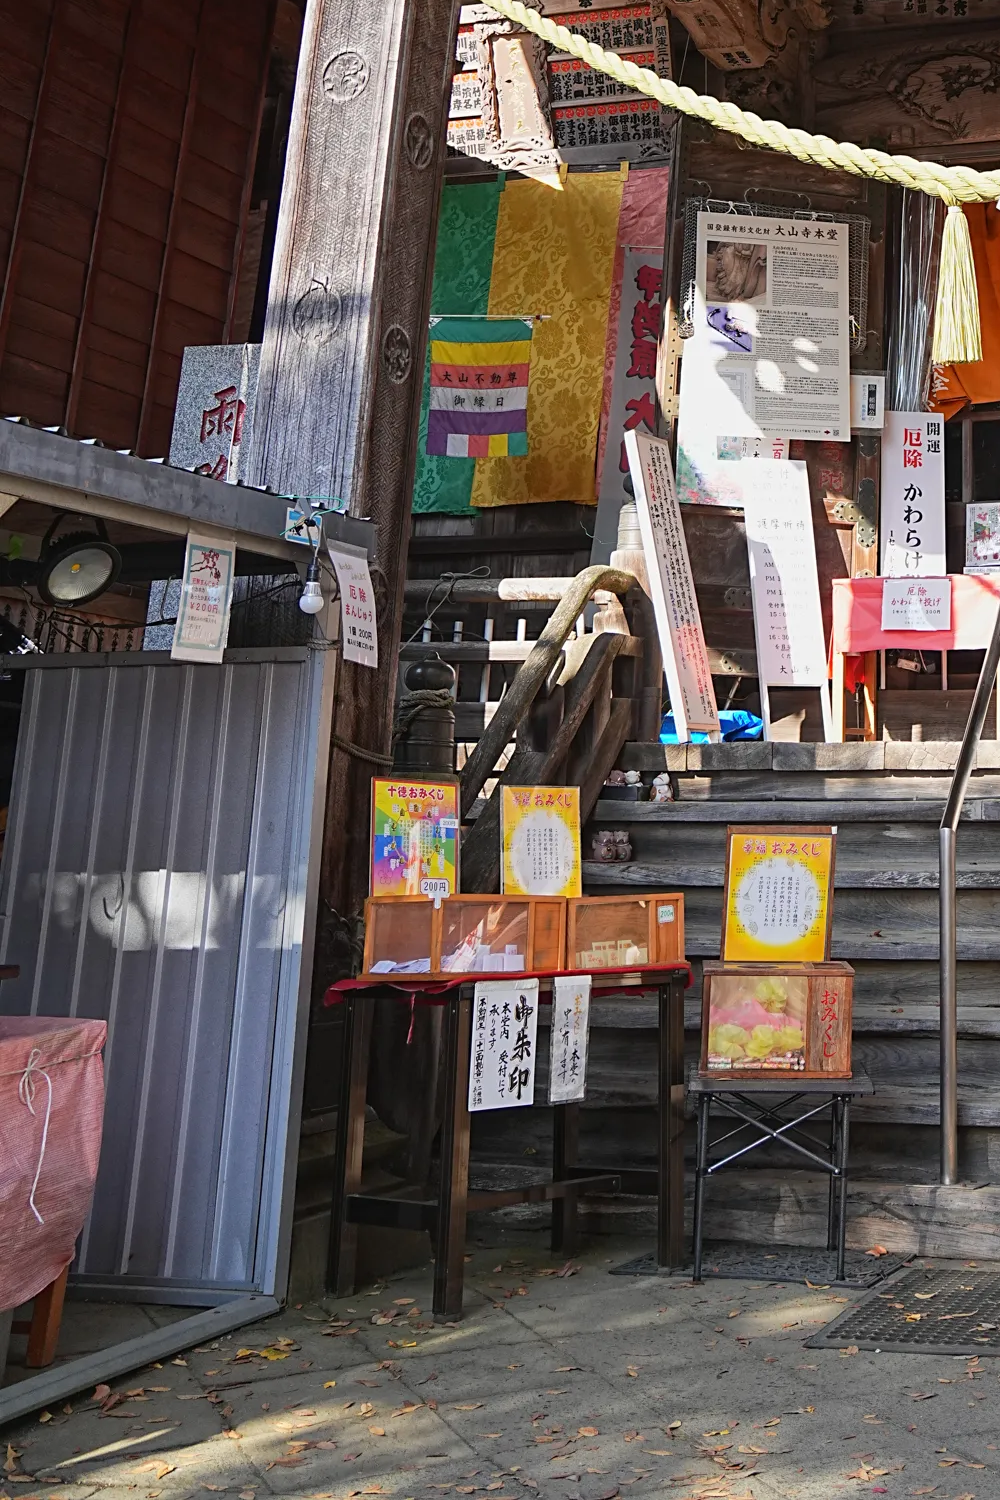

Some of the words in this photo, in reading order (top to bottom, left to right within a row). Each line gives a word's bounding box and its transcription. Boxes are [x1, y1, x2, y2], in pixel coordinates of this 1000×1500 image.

[707, 223, 770, 235] 国登録有形文化財
[774, 224, 838, 241] 大山寺本堂
[443, 371, 517, 384] 大山不動尊
[454, 395, 504, 407] 御縁日
[927, 422, 941, 453] 開運
[904, 428, 923, 468] 厄除
[349, 585, 367, 602] 厄除
[907, 586, 927, 596] 厄除
[345, 604, 373, 623] まんじゅう
[358, 628, 373, 642] 200円
[779, 664, 811, 675] 大山寺
[388, 786, 444, 801] 十徳おみくじ
[424, 881, 446, 892] 200円
[500, 1002, 511, 1040] 本堂内
[820, 989, 838, 1058] おみくじ
[508, 995, 533, 1100] 御朱印
[498, 1050, 509, 1098] 受付にて
